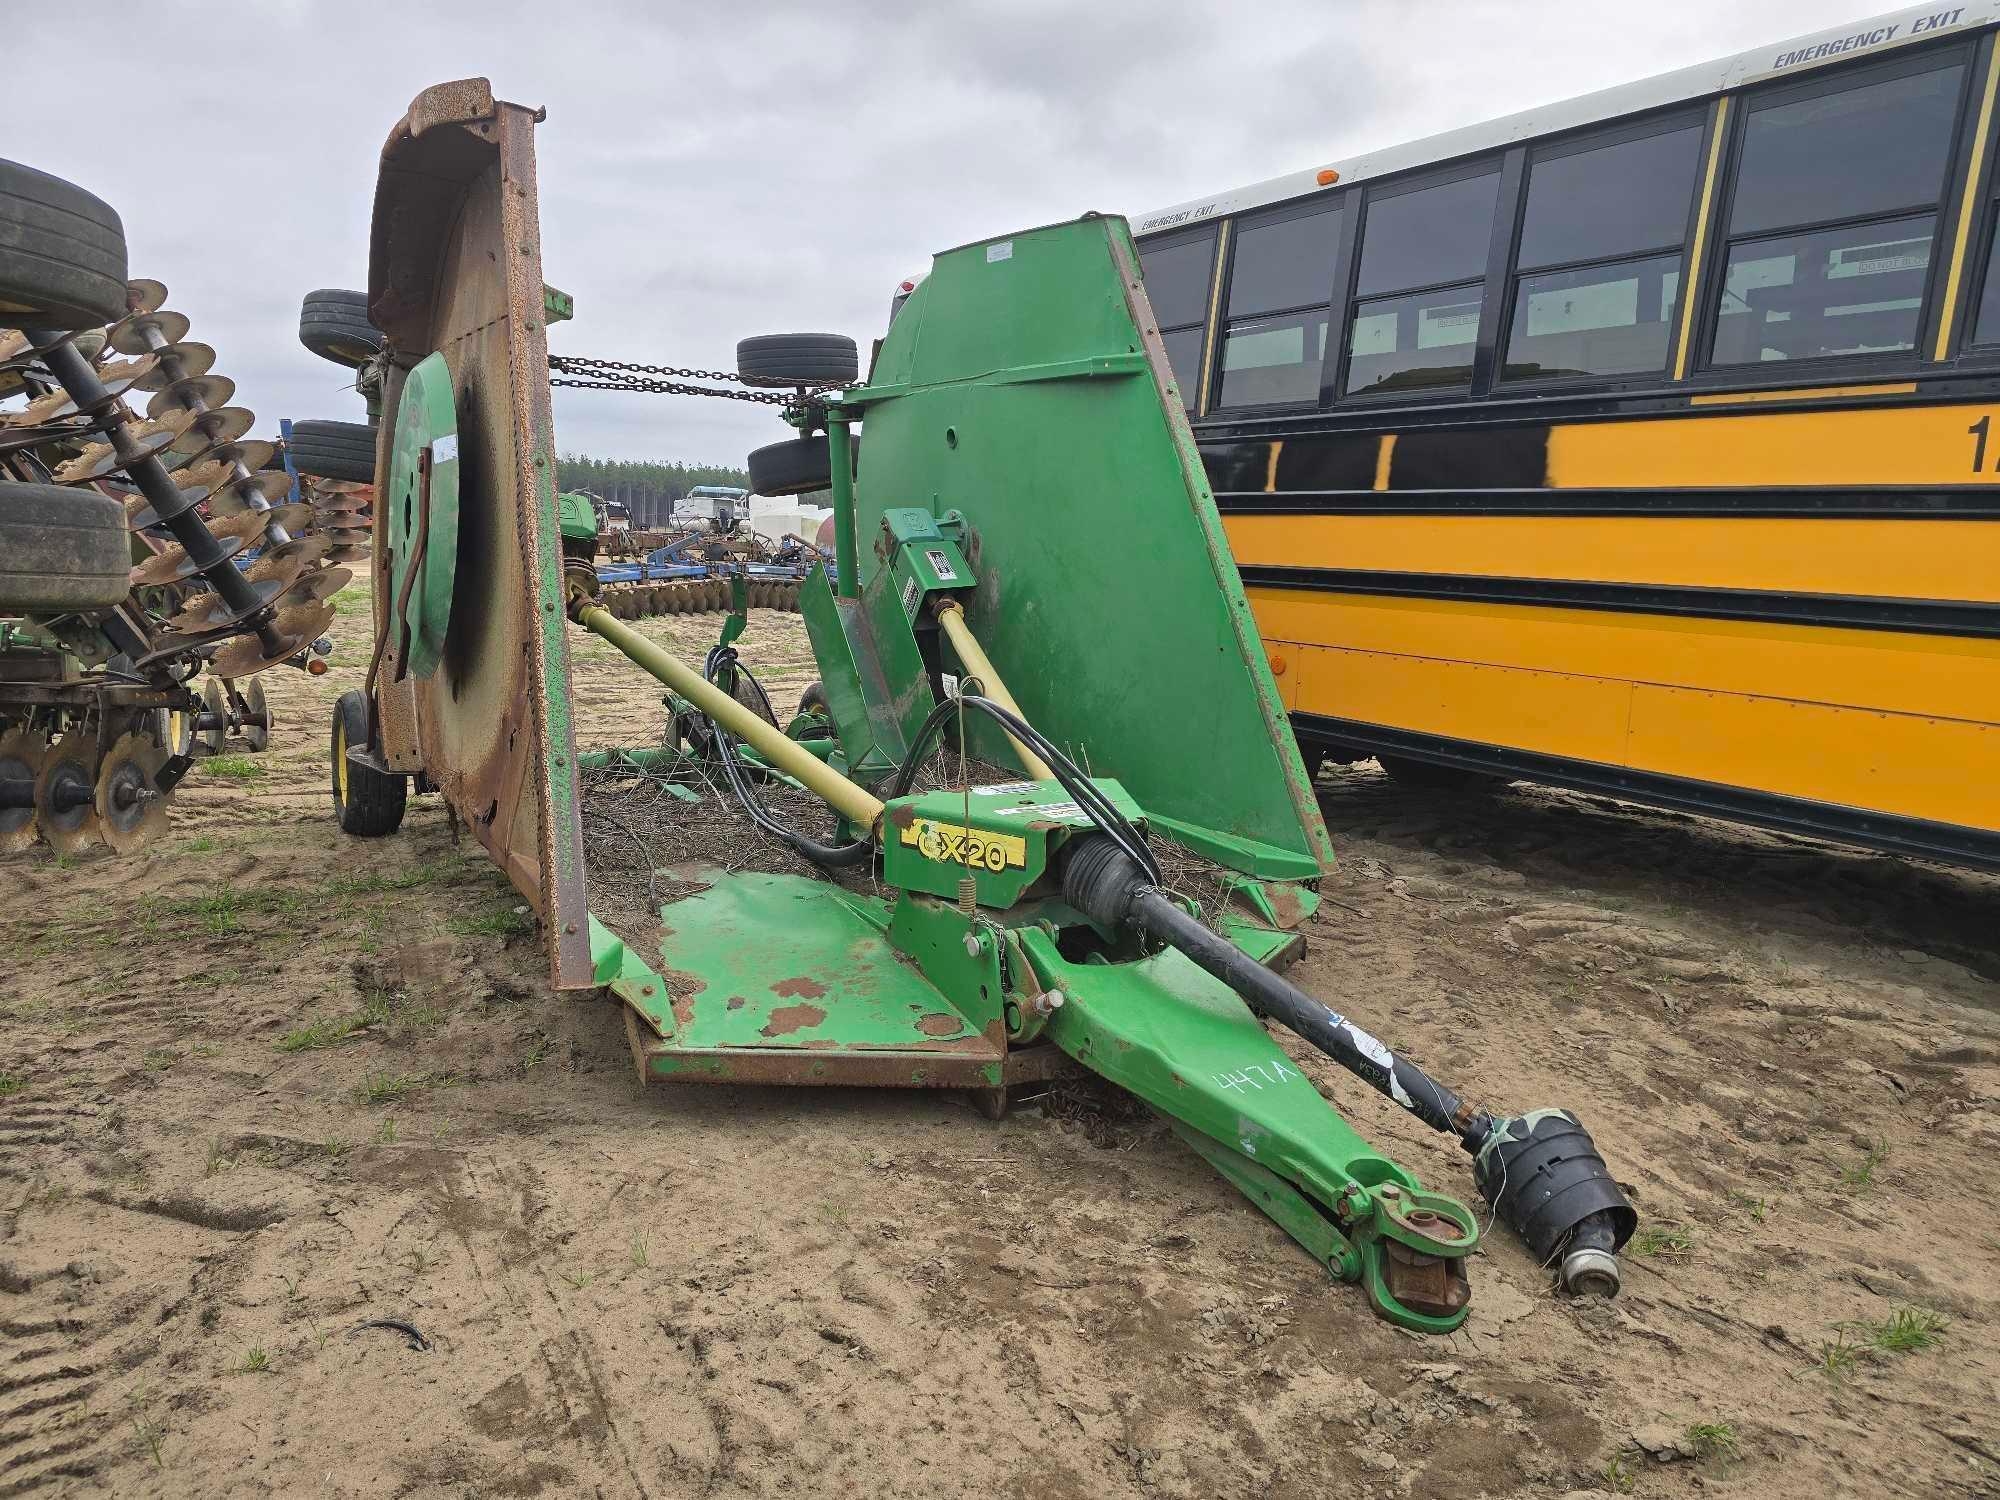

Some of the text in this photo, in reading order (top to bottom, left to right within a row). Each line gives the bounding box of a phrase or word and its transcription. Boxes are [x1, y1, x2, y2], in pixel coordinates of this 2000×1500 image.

[1773, 8, 1965, 69] EMERGENCY EXIT
[1142, 203, 1216, 230] EMERGENCY EXIT
[1968, 416, 2000, 472] 1
[1212, 1060, 1297, 1094] 447A
